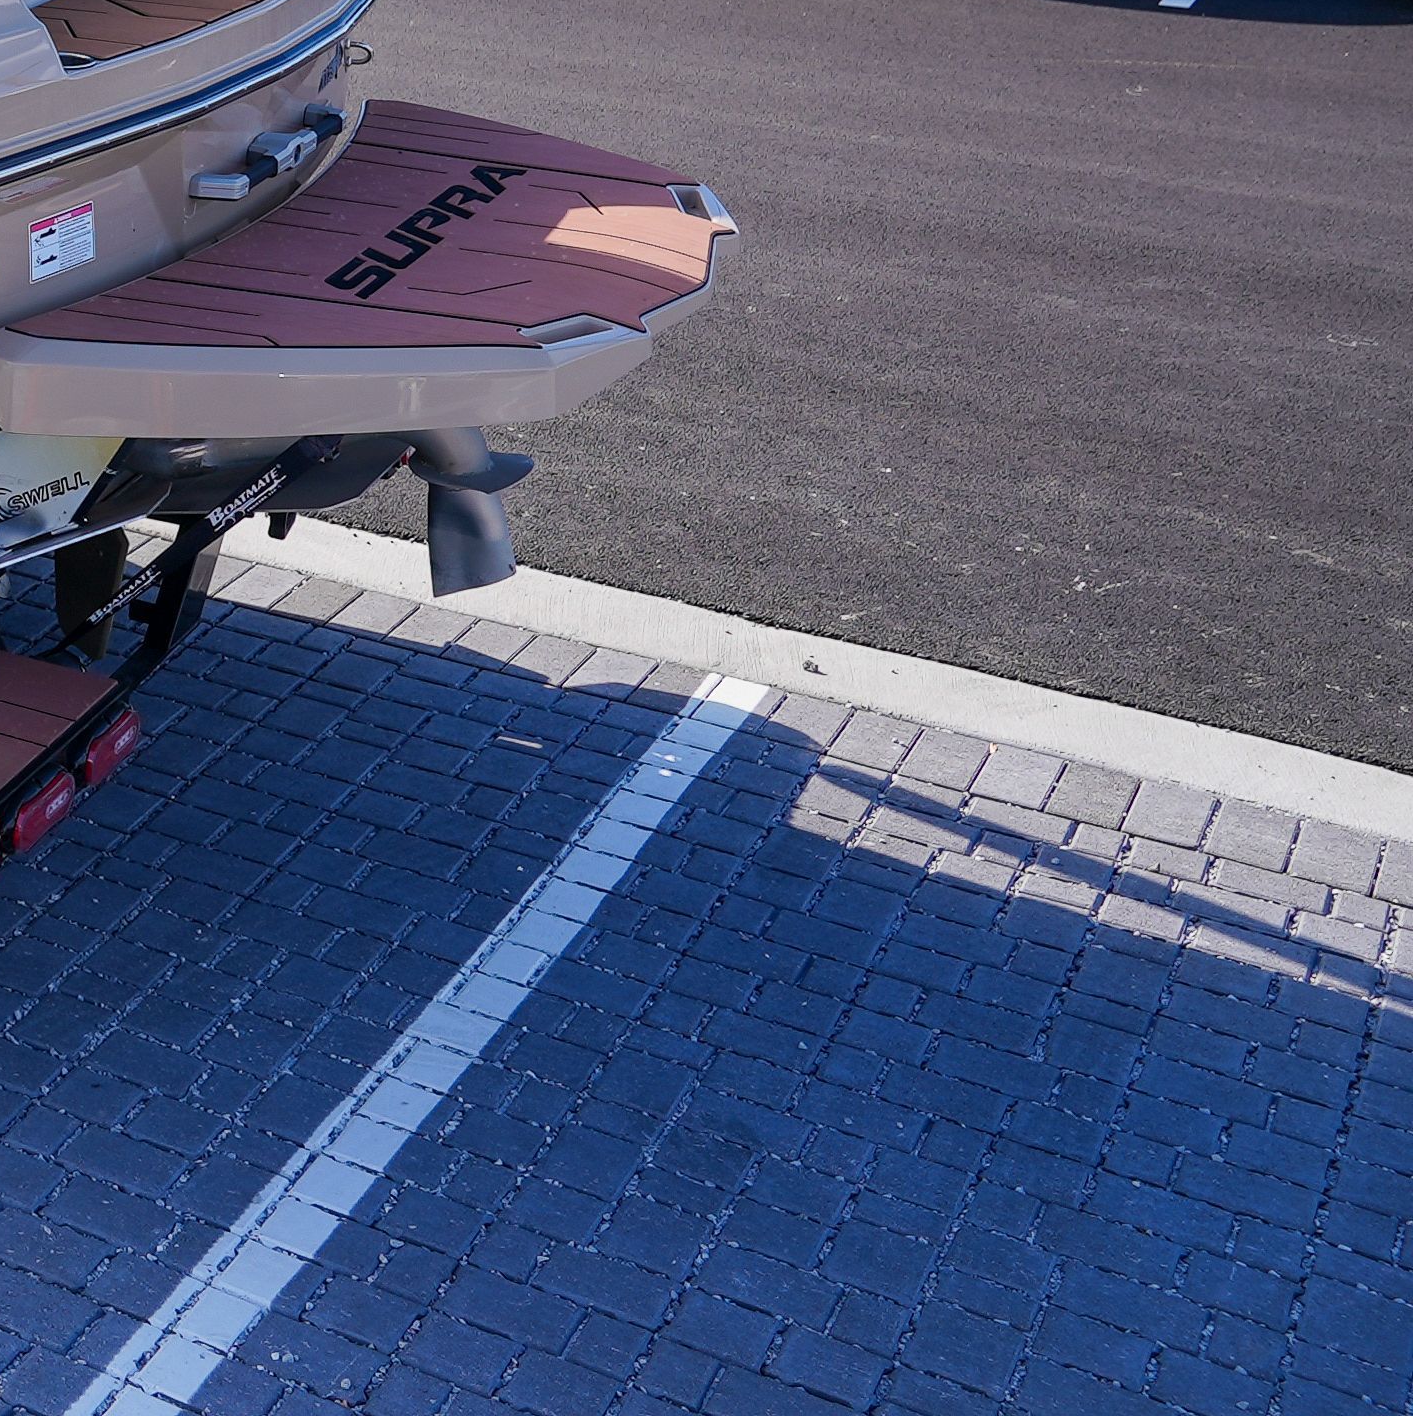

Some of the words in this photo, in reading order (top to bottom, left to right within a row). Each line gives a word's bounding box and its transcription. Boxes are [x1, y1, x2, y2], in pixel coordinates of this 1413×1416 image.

[324, 164, 528, 300] SUPRA
[7, 472, 90, 516] SWELL
[204, 466, 280, 527] BOATMATE
